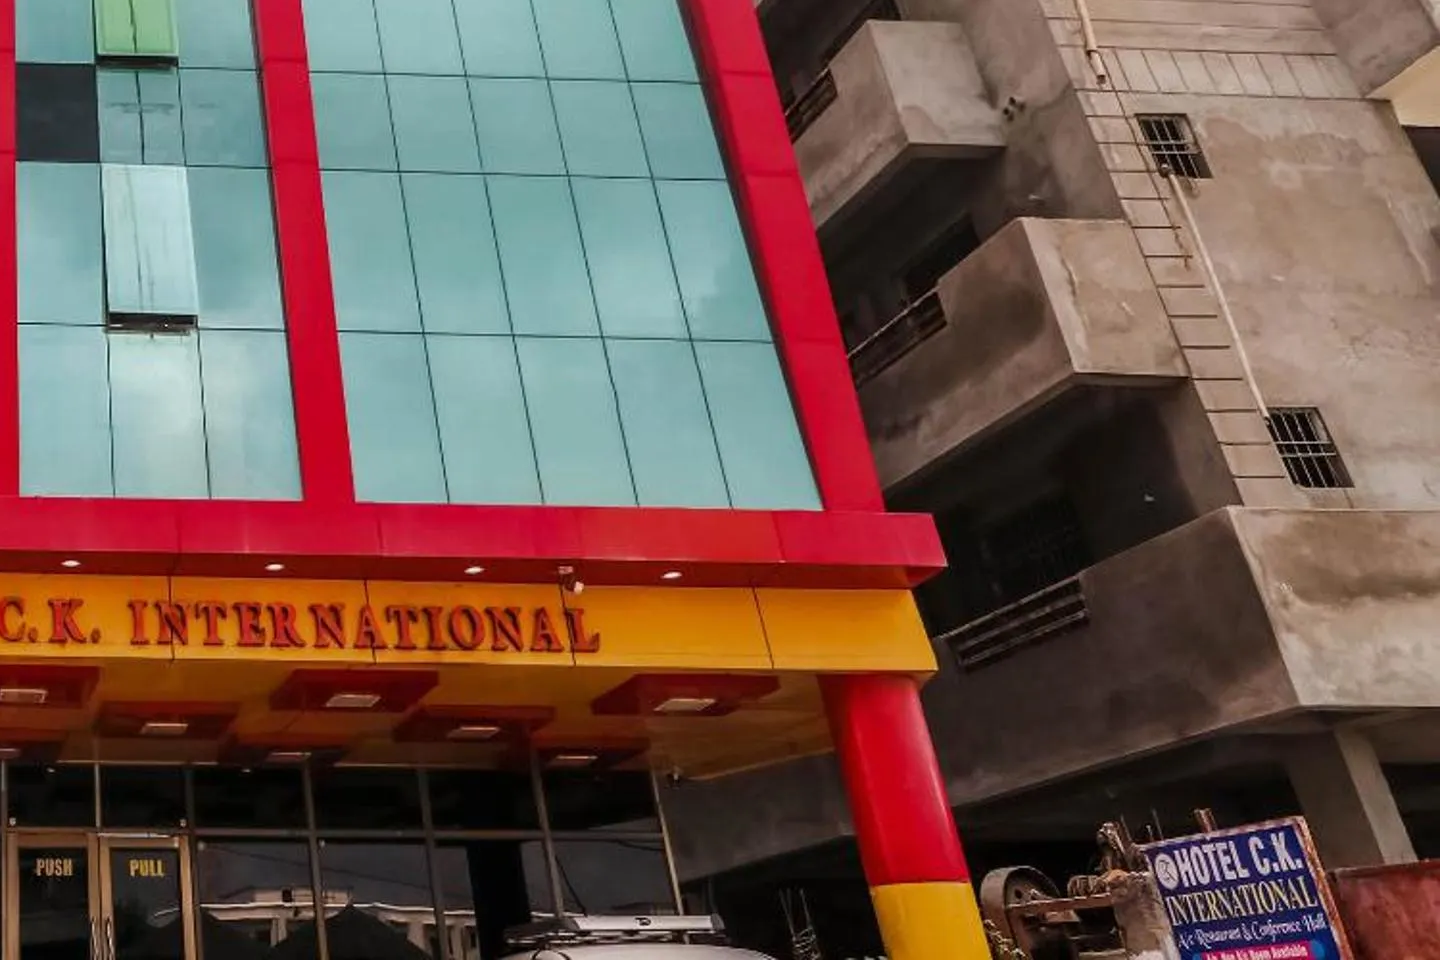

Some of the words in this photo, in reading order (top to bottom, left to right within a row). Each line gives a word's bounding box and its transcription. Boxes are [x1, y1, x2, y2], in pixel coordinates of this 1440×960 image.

[127, 598, 601, 654] INTERNATIONAL
[35, 858, 73, 876] PUSH
[129, 859, 164, 877] PULL
[1173, 840, 1250, 887] HOTEL
[1248, 832, 1303, 875] C.K.
[1165, 876, 1318, 926] INTERNATIONAL
